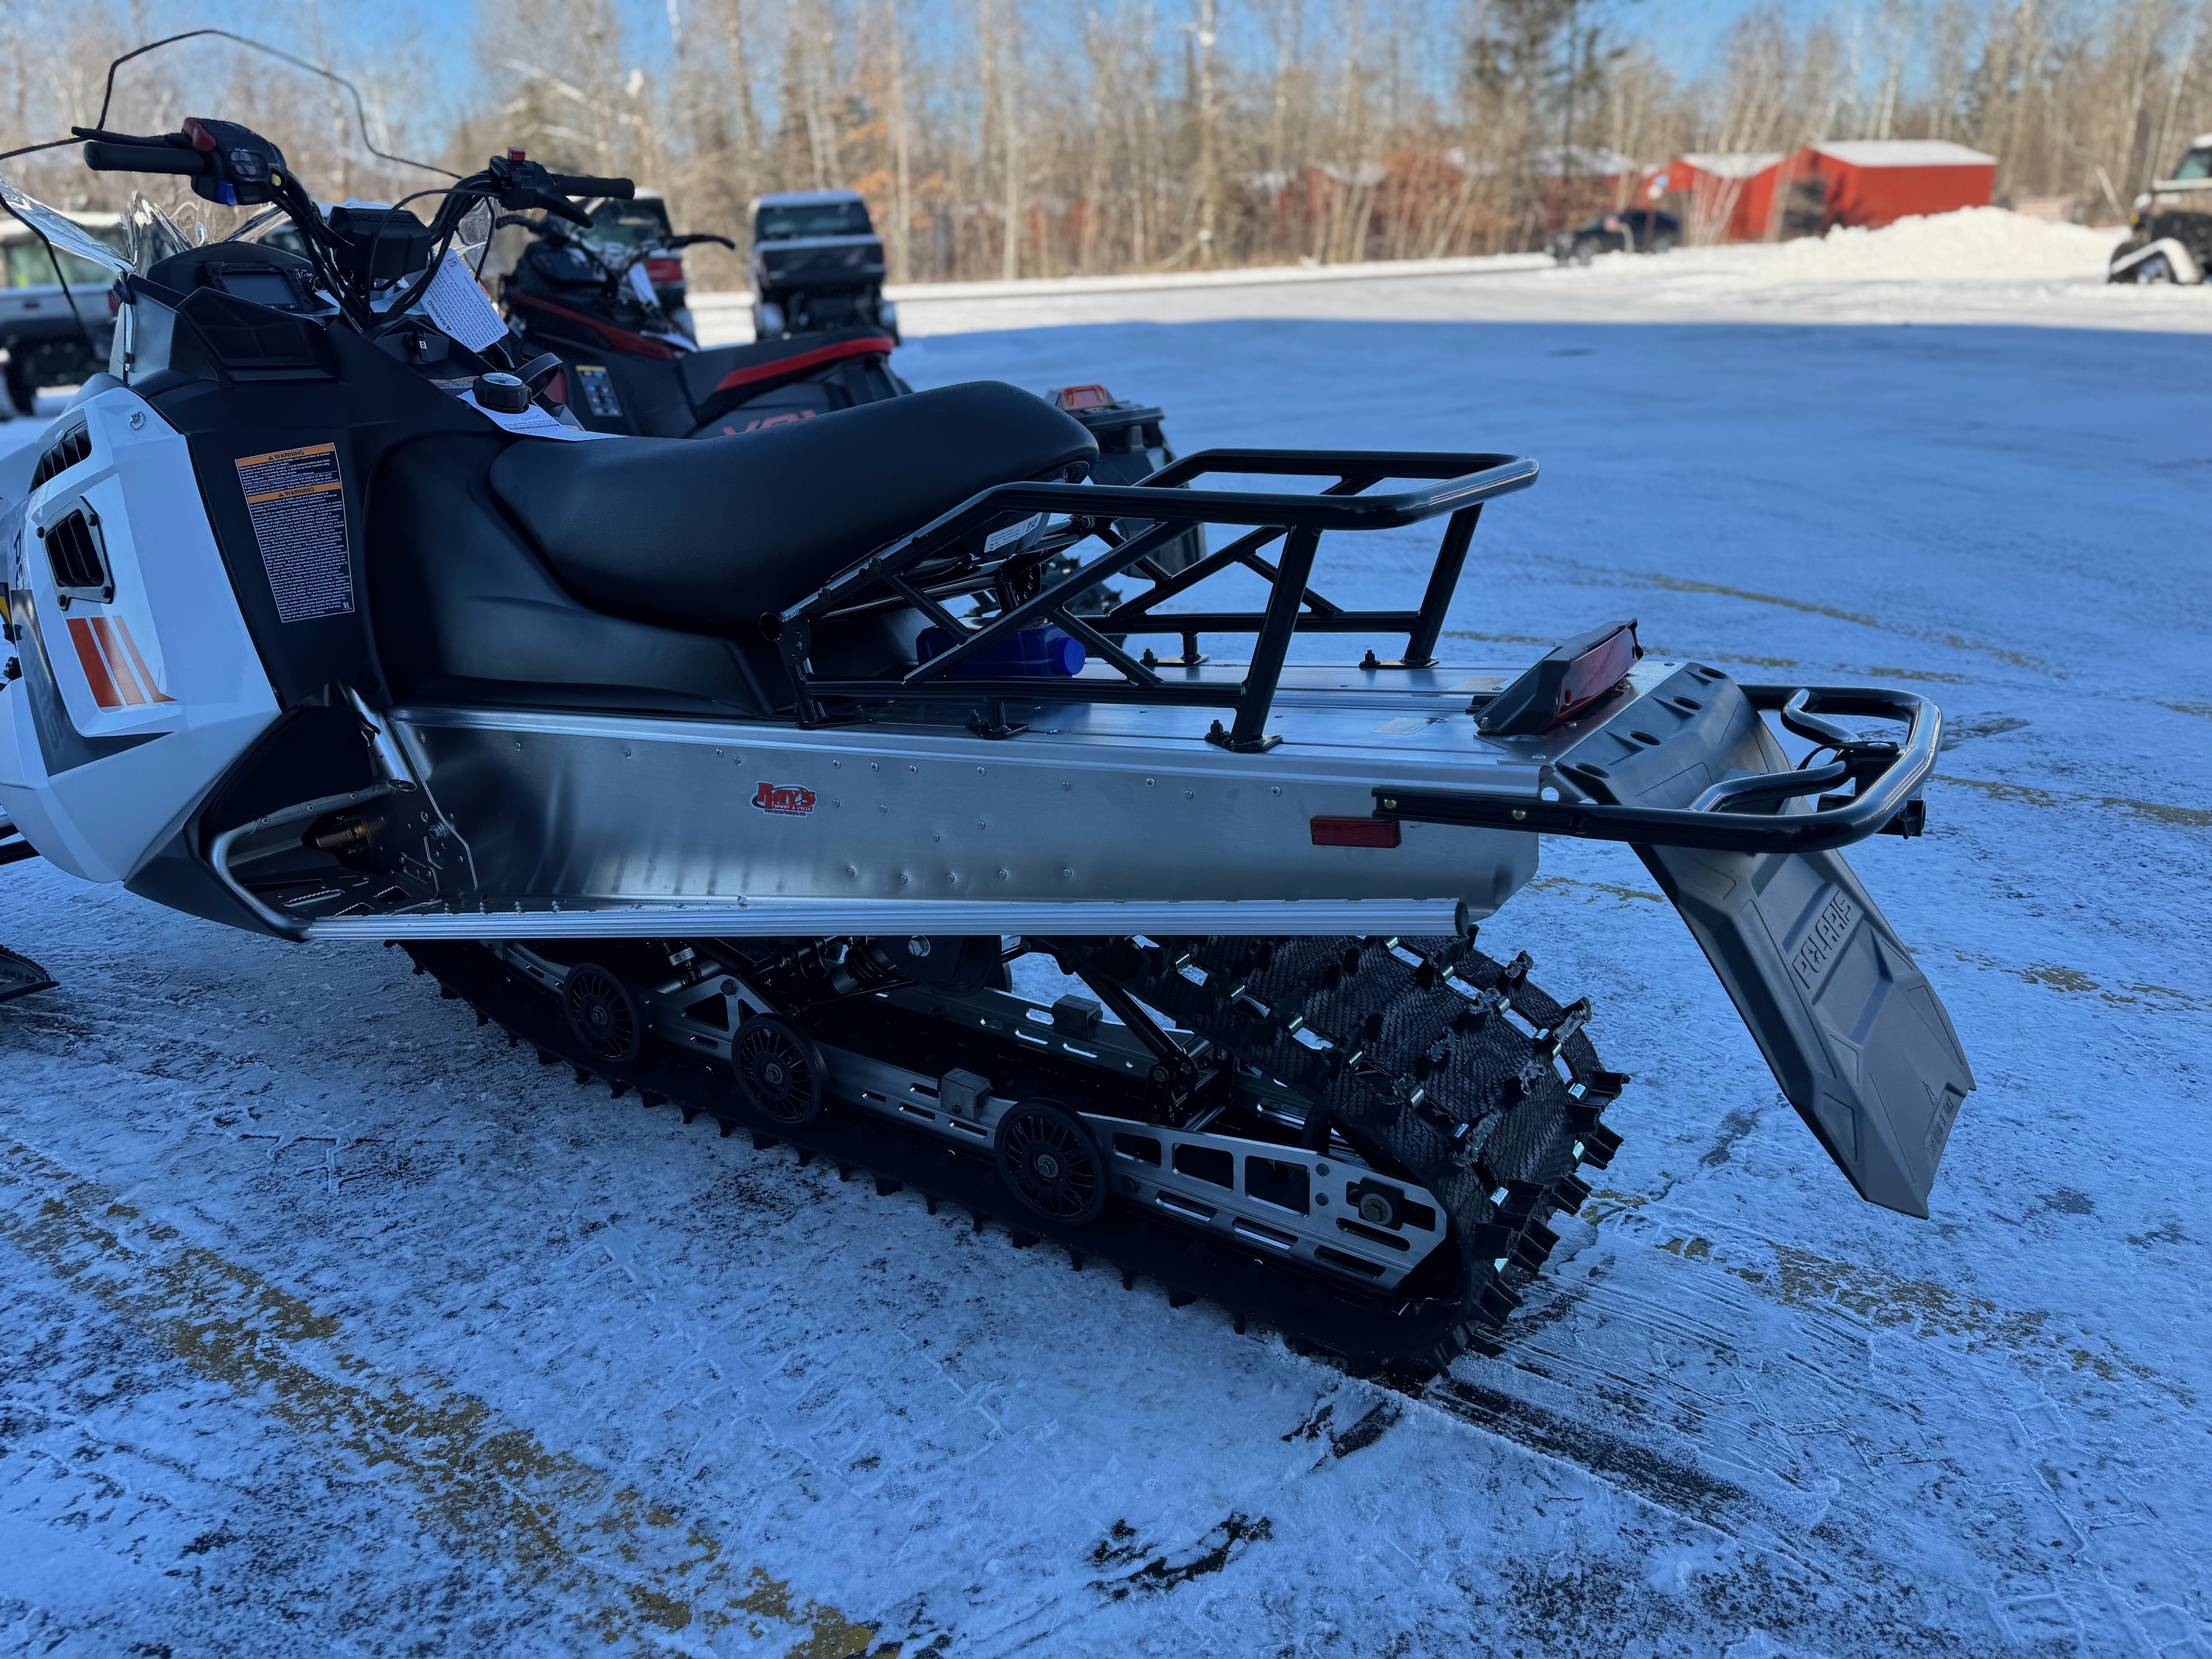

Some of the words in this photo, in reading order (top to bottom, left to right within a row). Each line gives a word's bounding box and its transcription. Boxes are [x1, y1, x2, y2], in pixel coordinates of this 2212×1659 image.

[428, 300, 447, 328] WARNING
[274, 450, 304, 459] WARNING
[284, 486, 314, 496] WARNING
[1791, 890, 1851, 990] POLARIS
